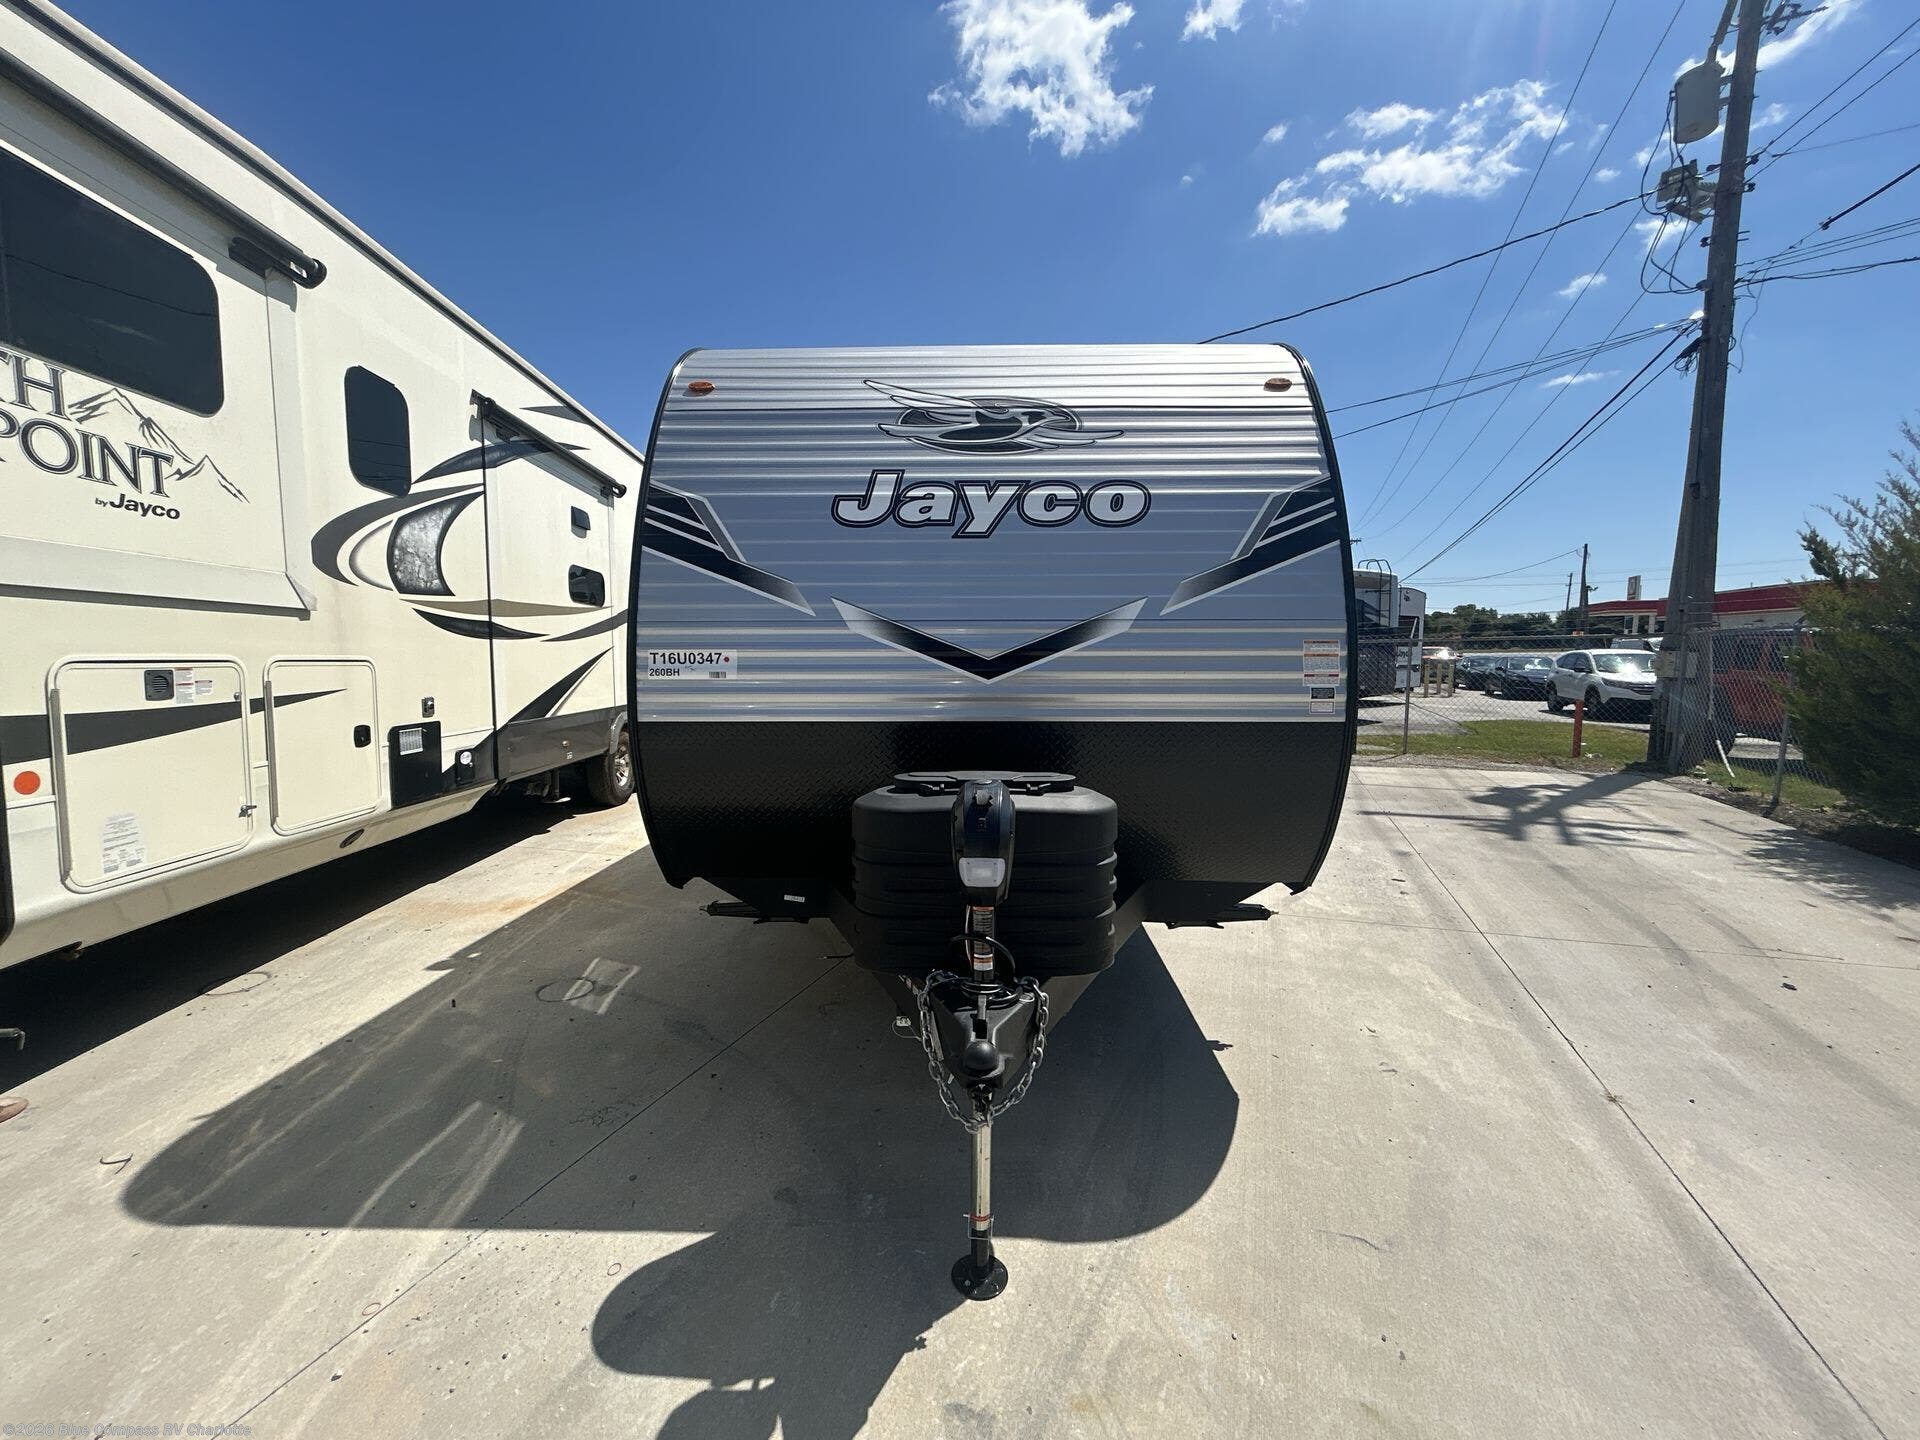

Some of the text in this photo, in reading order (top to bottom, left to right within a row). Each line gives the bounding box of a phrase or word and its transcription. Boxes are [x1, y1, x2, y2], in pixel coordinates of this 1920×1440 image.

[0, 349, 72, 422] H
[95, 493, 181, 520] by Jayco
[831, 469, 1152, 539] Jayco
[649, 652, 722, 665] T16U0347
[649, 668, 680, 677] 260BH
